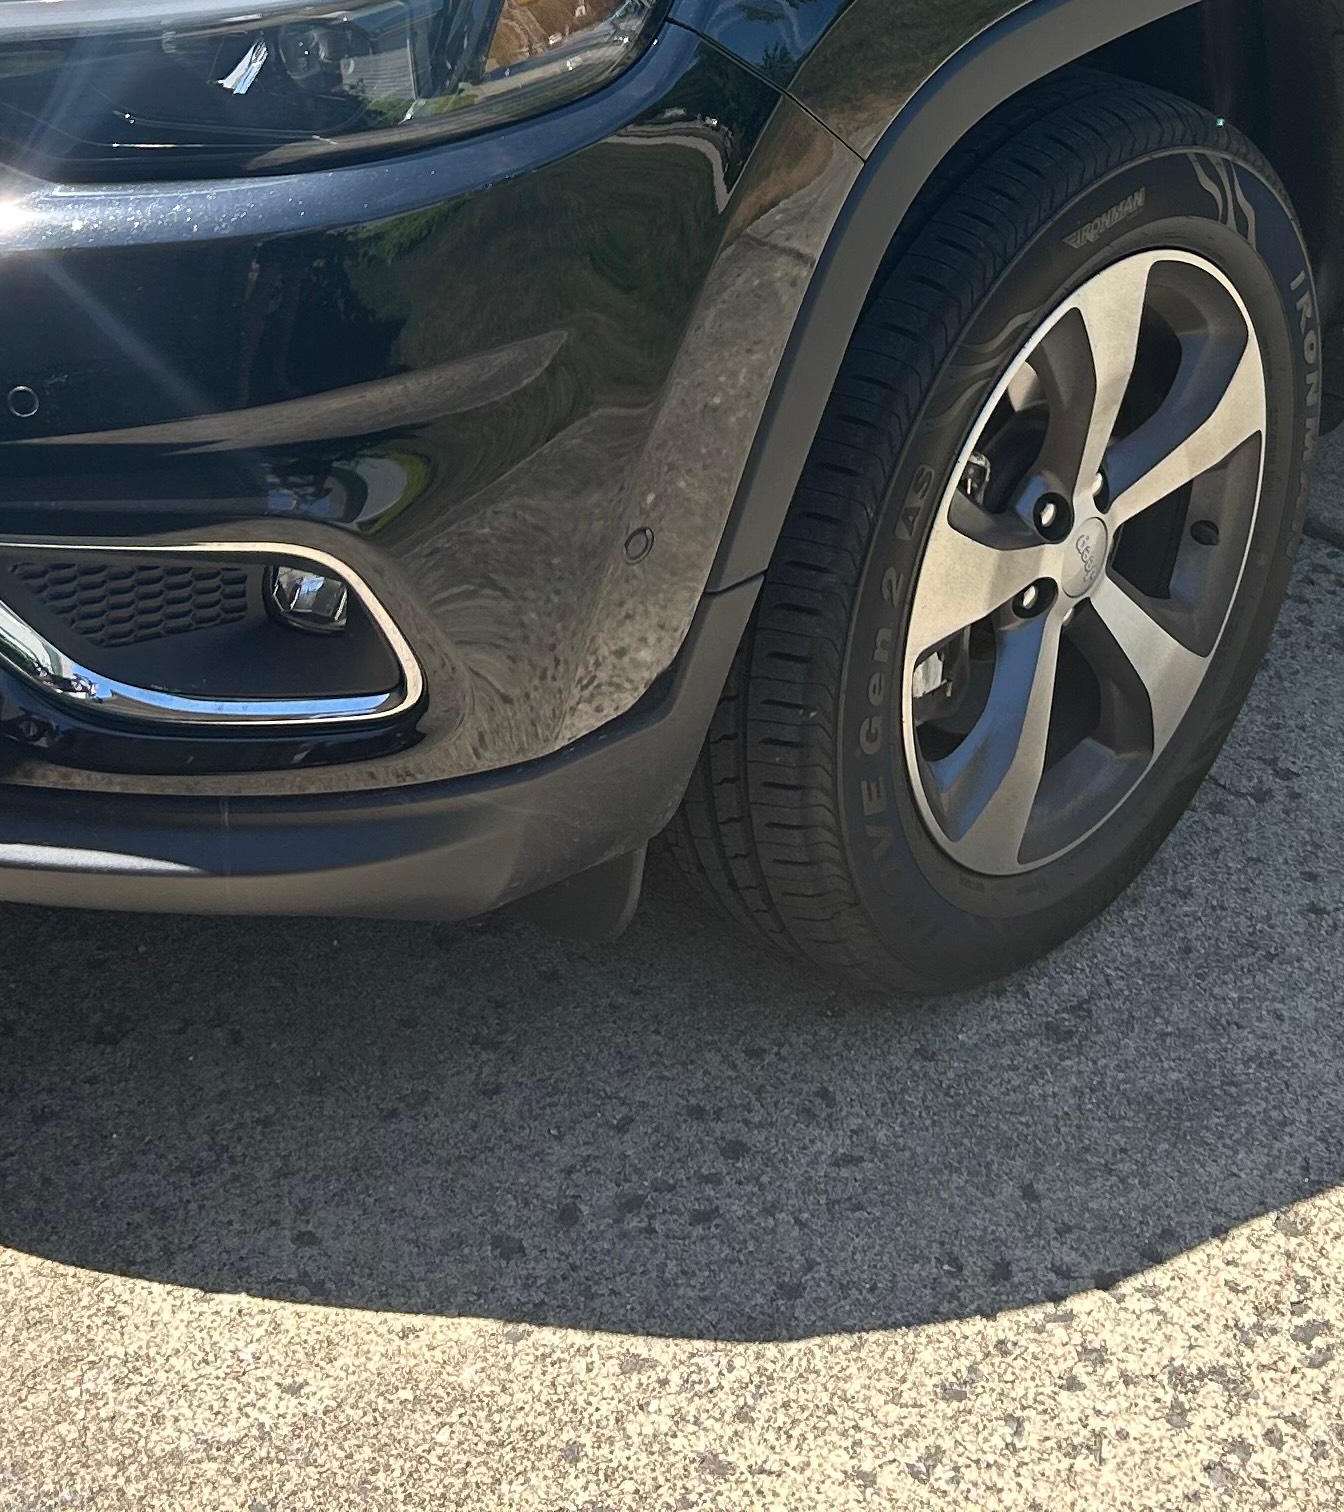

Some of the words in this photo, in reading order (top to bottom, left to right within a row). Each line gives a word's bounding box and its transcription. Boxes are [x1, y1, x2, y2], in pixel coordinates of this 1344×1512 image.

[1064, 186, 1146, 248] IRONMAN
[1075, 533, 1097, 583] Jeep
[858, 626, 893, 756] Gen
[881, 566, 905, 609] 2
[895, 464, 935, 540] AS
